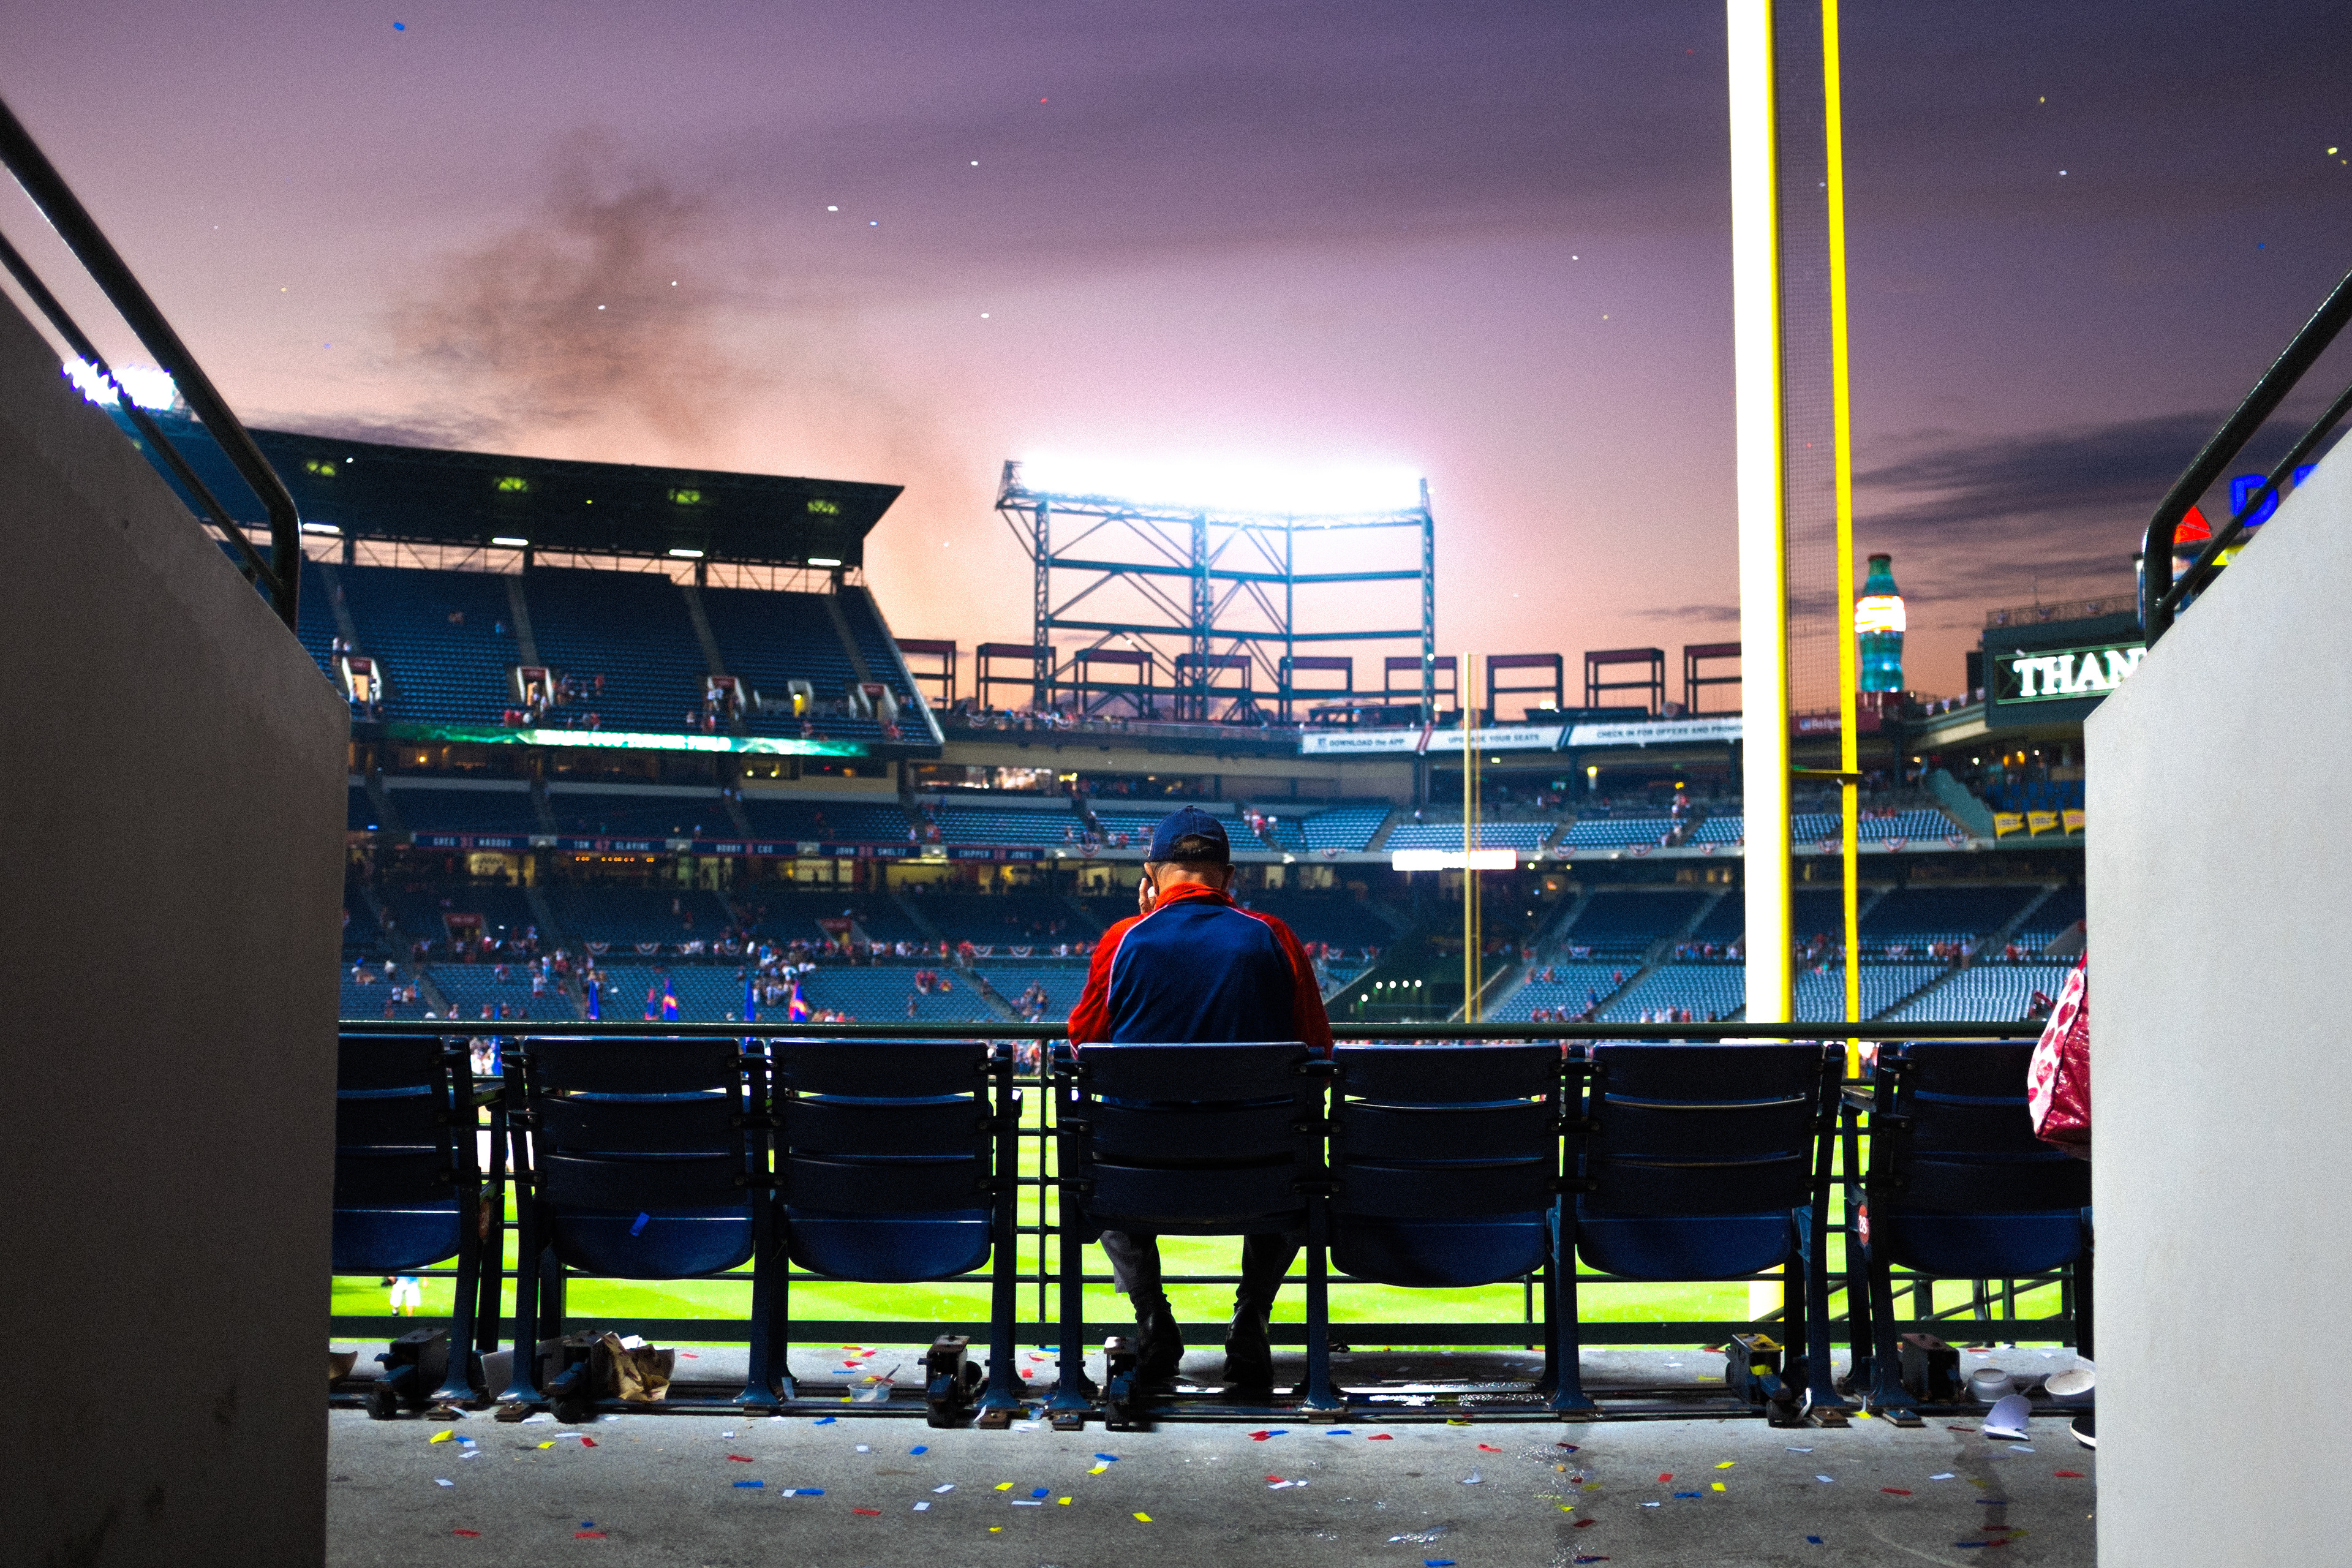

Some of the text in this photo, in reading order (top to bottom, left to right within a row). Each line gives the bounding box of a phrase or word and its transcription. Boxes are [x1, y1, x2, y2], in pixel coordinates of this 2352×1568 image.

[1489, 734, 1512, 742] YOUR
[1514, 733, 1540, 742] SEATS
[1596, 730, 1623, 739] CHECK
[1637, 728, 1653, 737] FOR
[1656, 727, 1689, 736] OFFERS
[1691, 726, 1709, 735] AND
